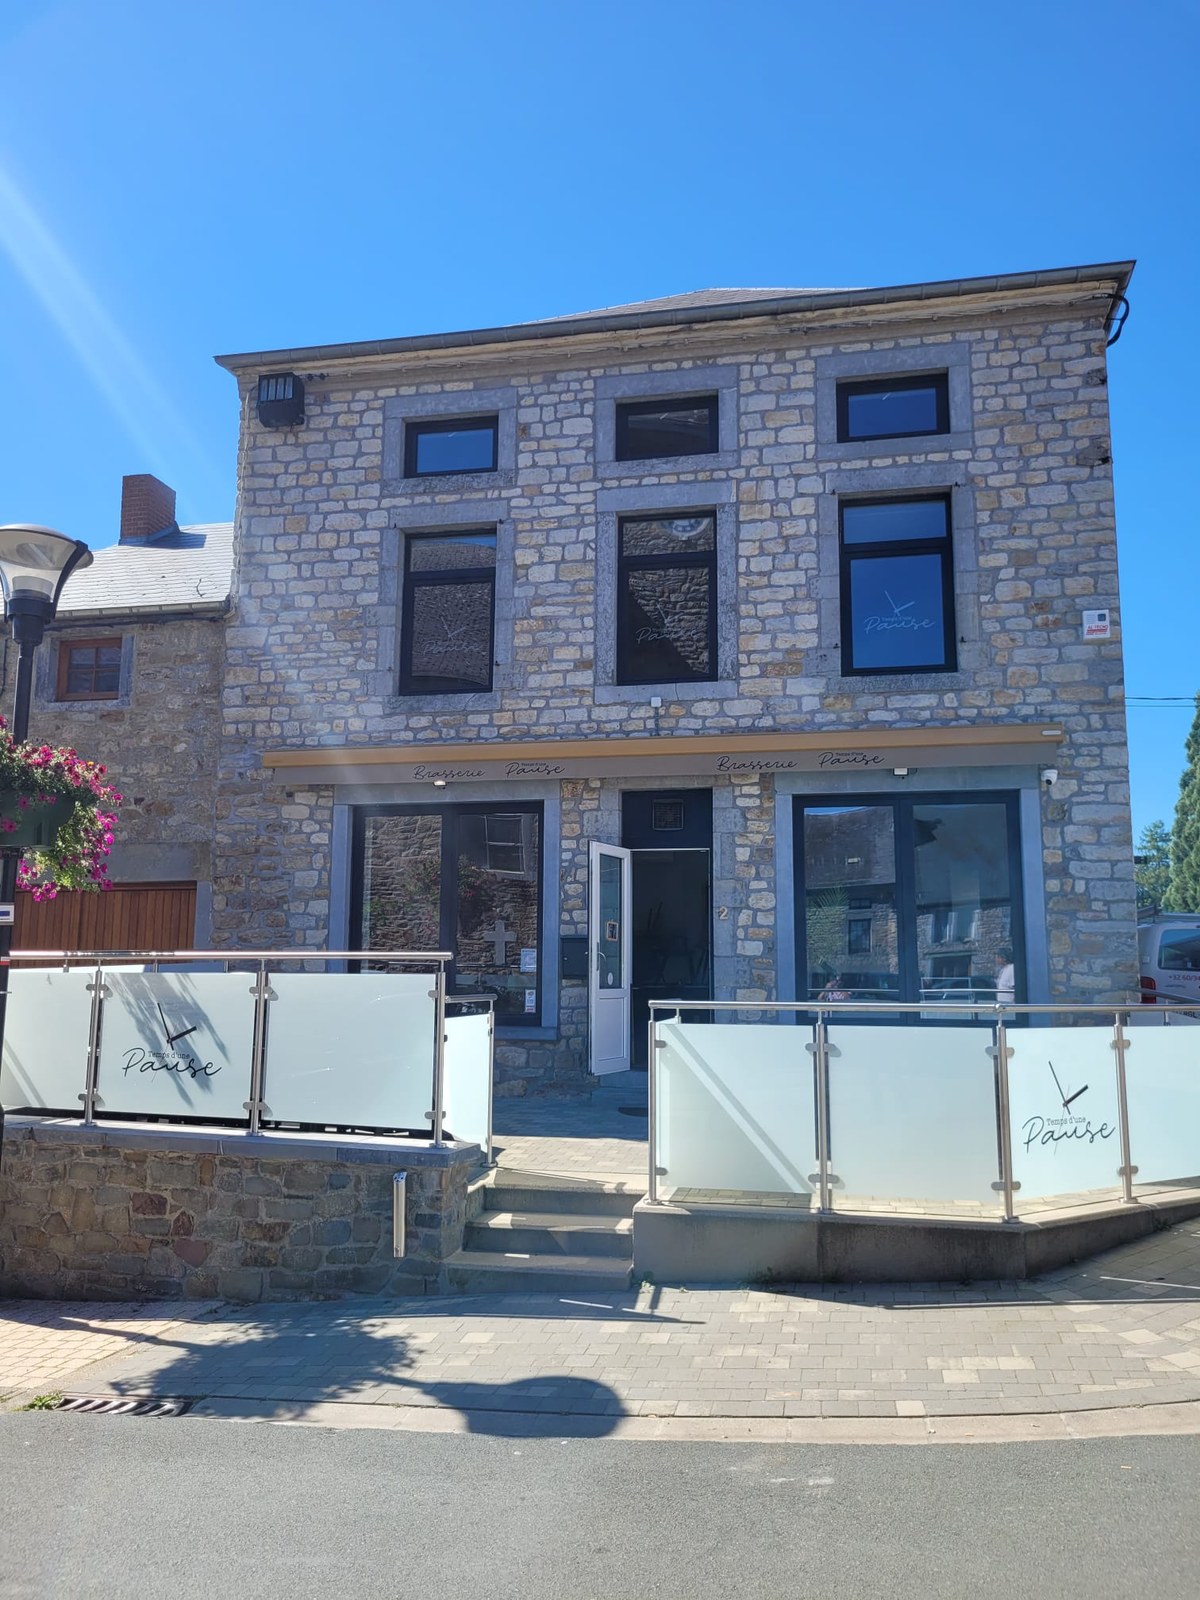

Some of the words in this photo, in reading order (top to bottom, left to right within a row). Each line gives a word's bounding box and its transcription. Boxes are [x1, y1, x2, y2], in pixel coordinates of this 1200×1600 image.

[413, 764, 486, 780] Brasserie
[505, 761, 565, 778] Pause
[716, 755, 800, 772] Brasserie
[818, 751, 885, 769] Pause
[122, 1047, 222, 1078] Pause
[148, 1051, 169, 1060] Temps
[170, 1051, 190, 1060] d'une
[1046, 1117, 1068, 1126] Temps
[1068, 1115, 1087, 1125] d'une
[1022, 1115, 1116, 1154] Pause
